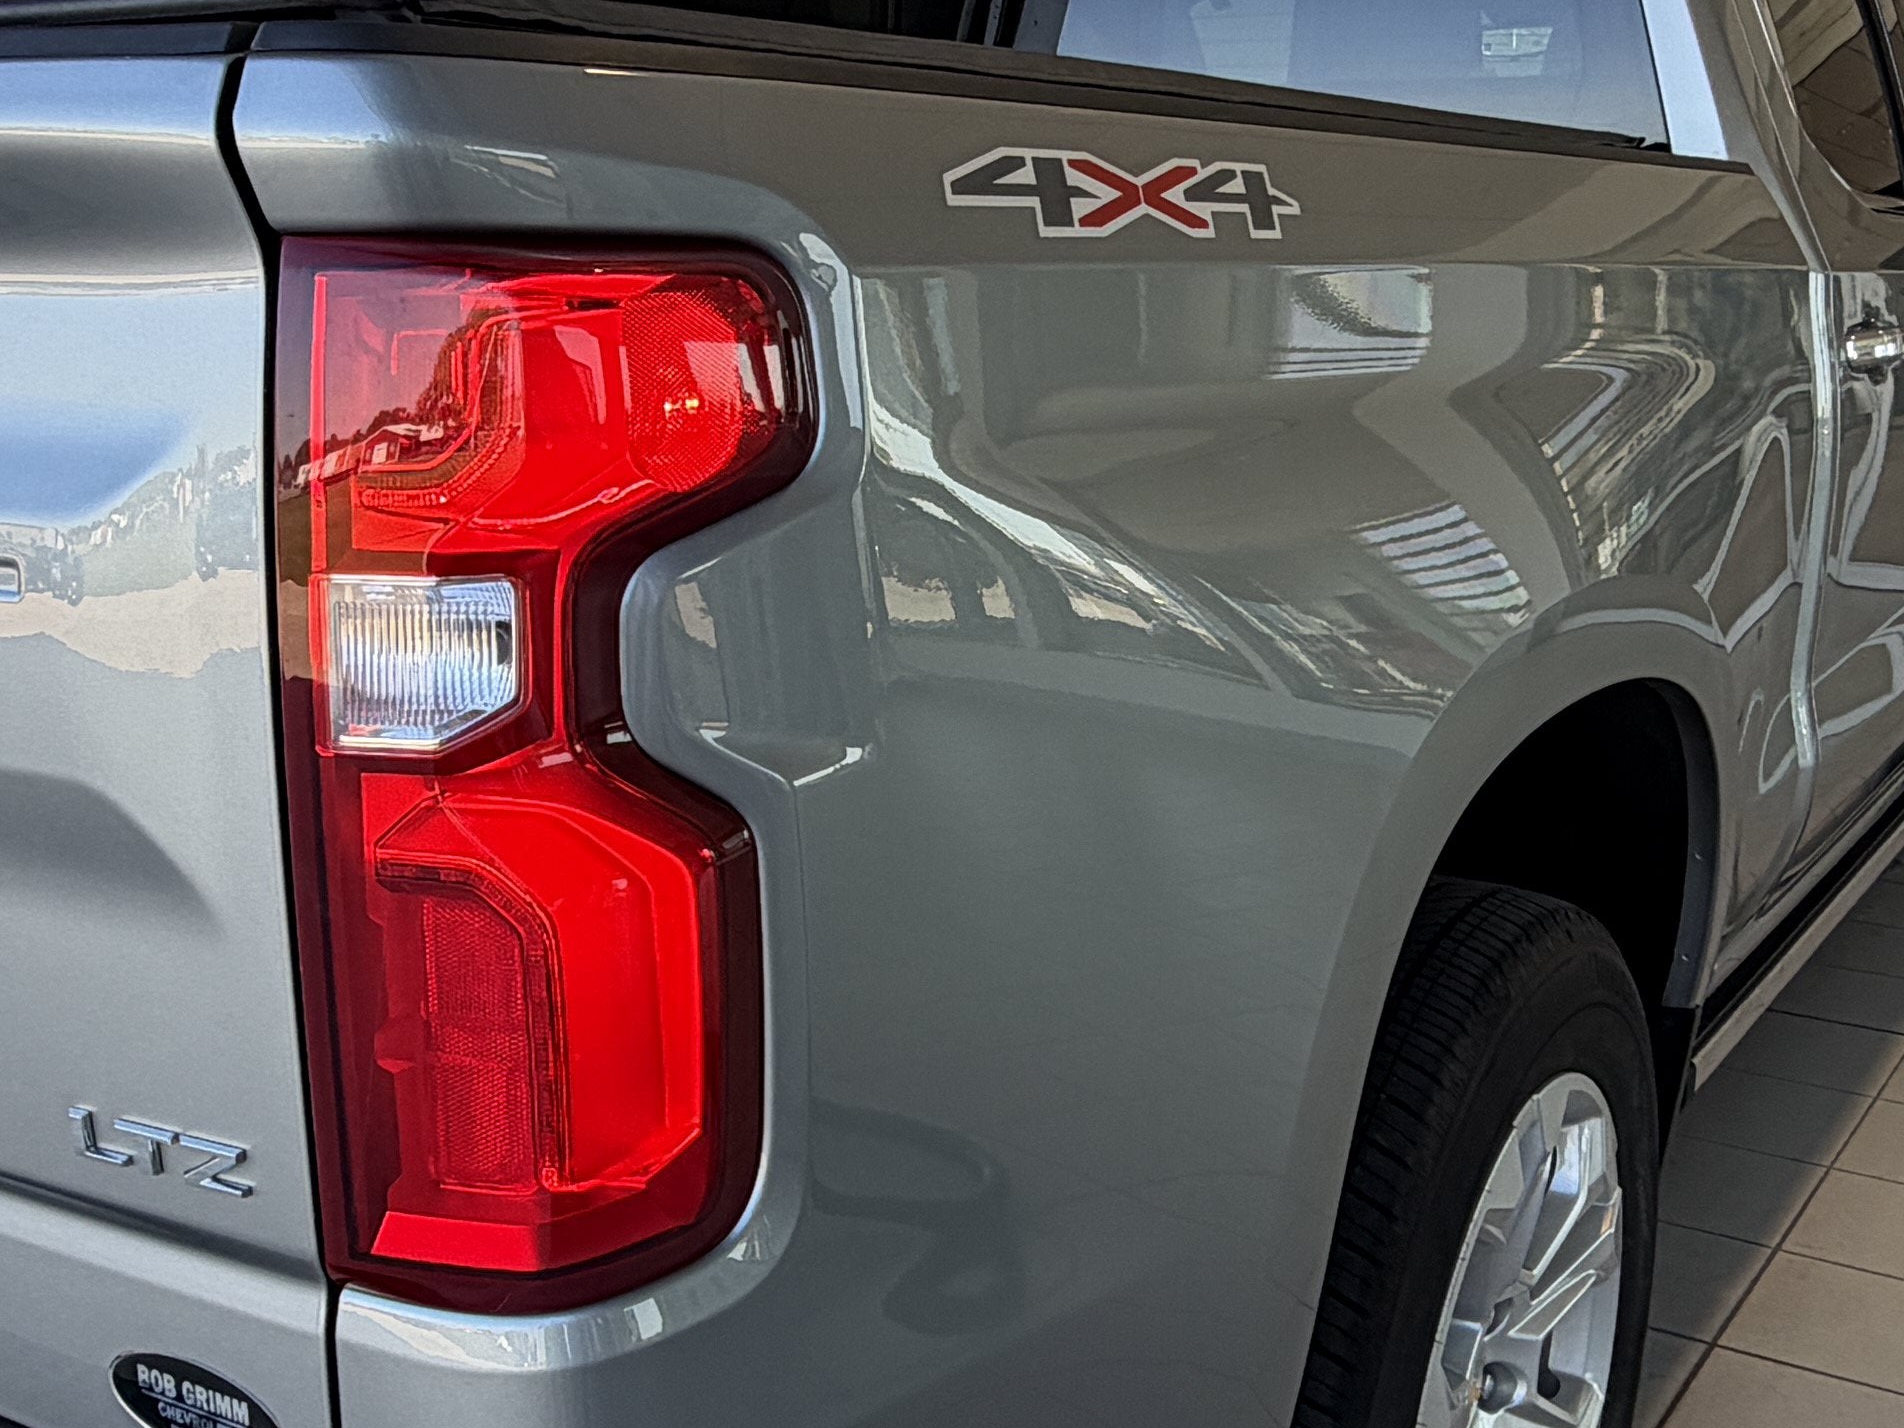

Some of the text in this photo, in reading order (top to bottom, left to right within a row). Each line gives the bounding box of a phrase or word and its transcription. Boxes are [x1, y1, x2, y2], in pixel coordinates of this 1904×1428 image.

[67, 1104, 255, 1199] LTZ
[136, 1363, 250, 1427] BOB GRIMM
